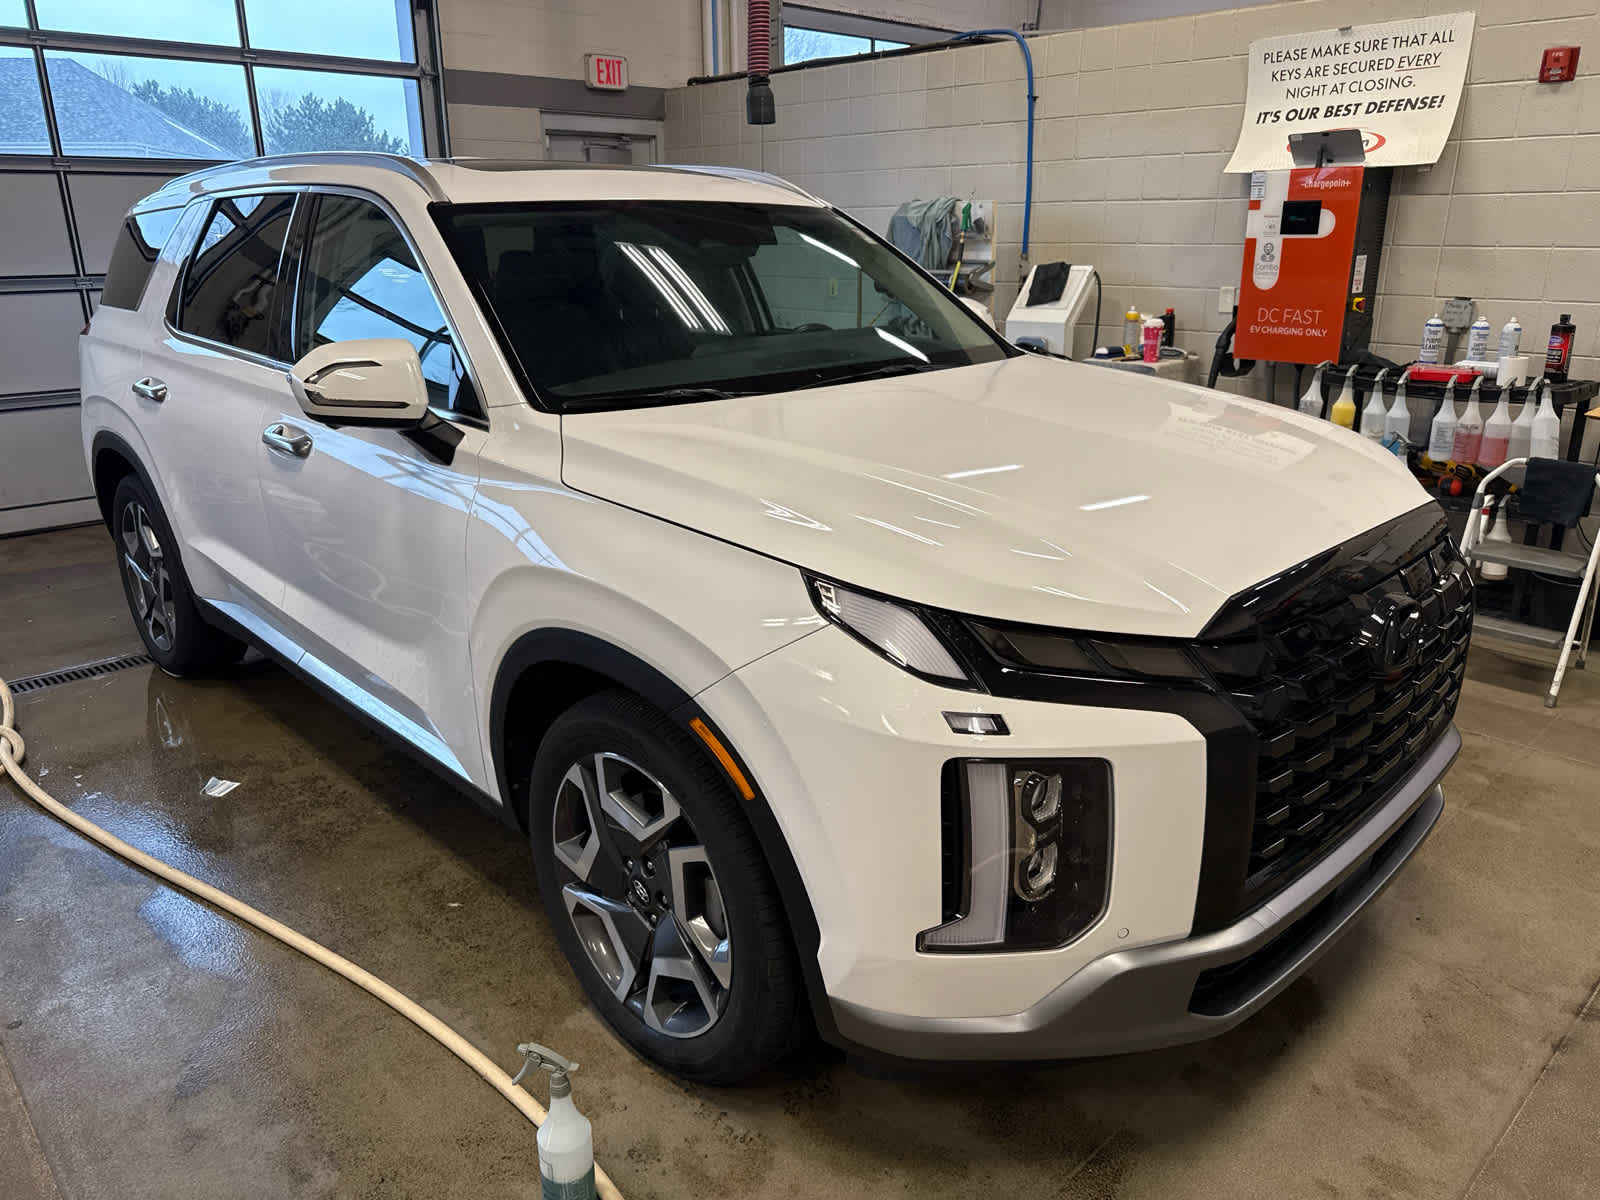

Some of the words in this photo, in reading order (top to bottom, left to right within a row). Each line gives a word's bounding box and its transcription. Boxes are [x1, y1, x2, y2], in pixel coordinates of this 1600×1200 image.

[1263, 48, 1308, 64] PLEASE
[1311, 42, 1351, 59] MAKE
[1353, 37, 1389, 54] SURE
[1392, 33, 1428, 49] THAT
[1429, 29, 1455, 45] ALL
[596, 58, 623, 86] EXIT
[1271, 67, 1301, 82] KEYS
[1303, 64, 1330, 79] ARE
[1332, 57, 1395, 76] SECURED
[1397, 51, 1442, 69] EVERY
[1285, 84, 1328, 100] NIGHT
[1329, 82, 1347, 96] AT
[1348, 75, 1416, 93] CLOSING.
[1256, 110, 1282, 125] IT'S
[1285, 106, 1320, 122] OUR
[1323, 102, 1363, 118] BEST
[1364, 94, 1446, 115] DEFENSE!
[1257, 307, 1280, 323] DC
[1282, 308, 1324, 325] FAST
[1249, 325, 1261, 333] EV
[1261, 326, 1304, 336] CHARGING
[1305, 328, 1328, 337] ONLY
